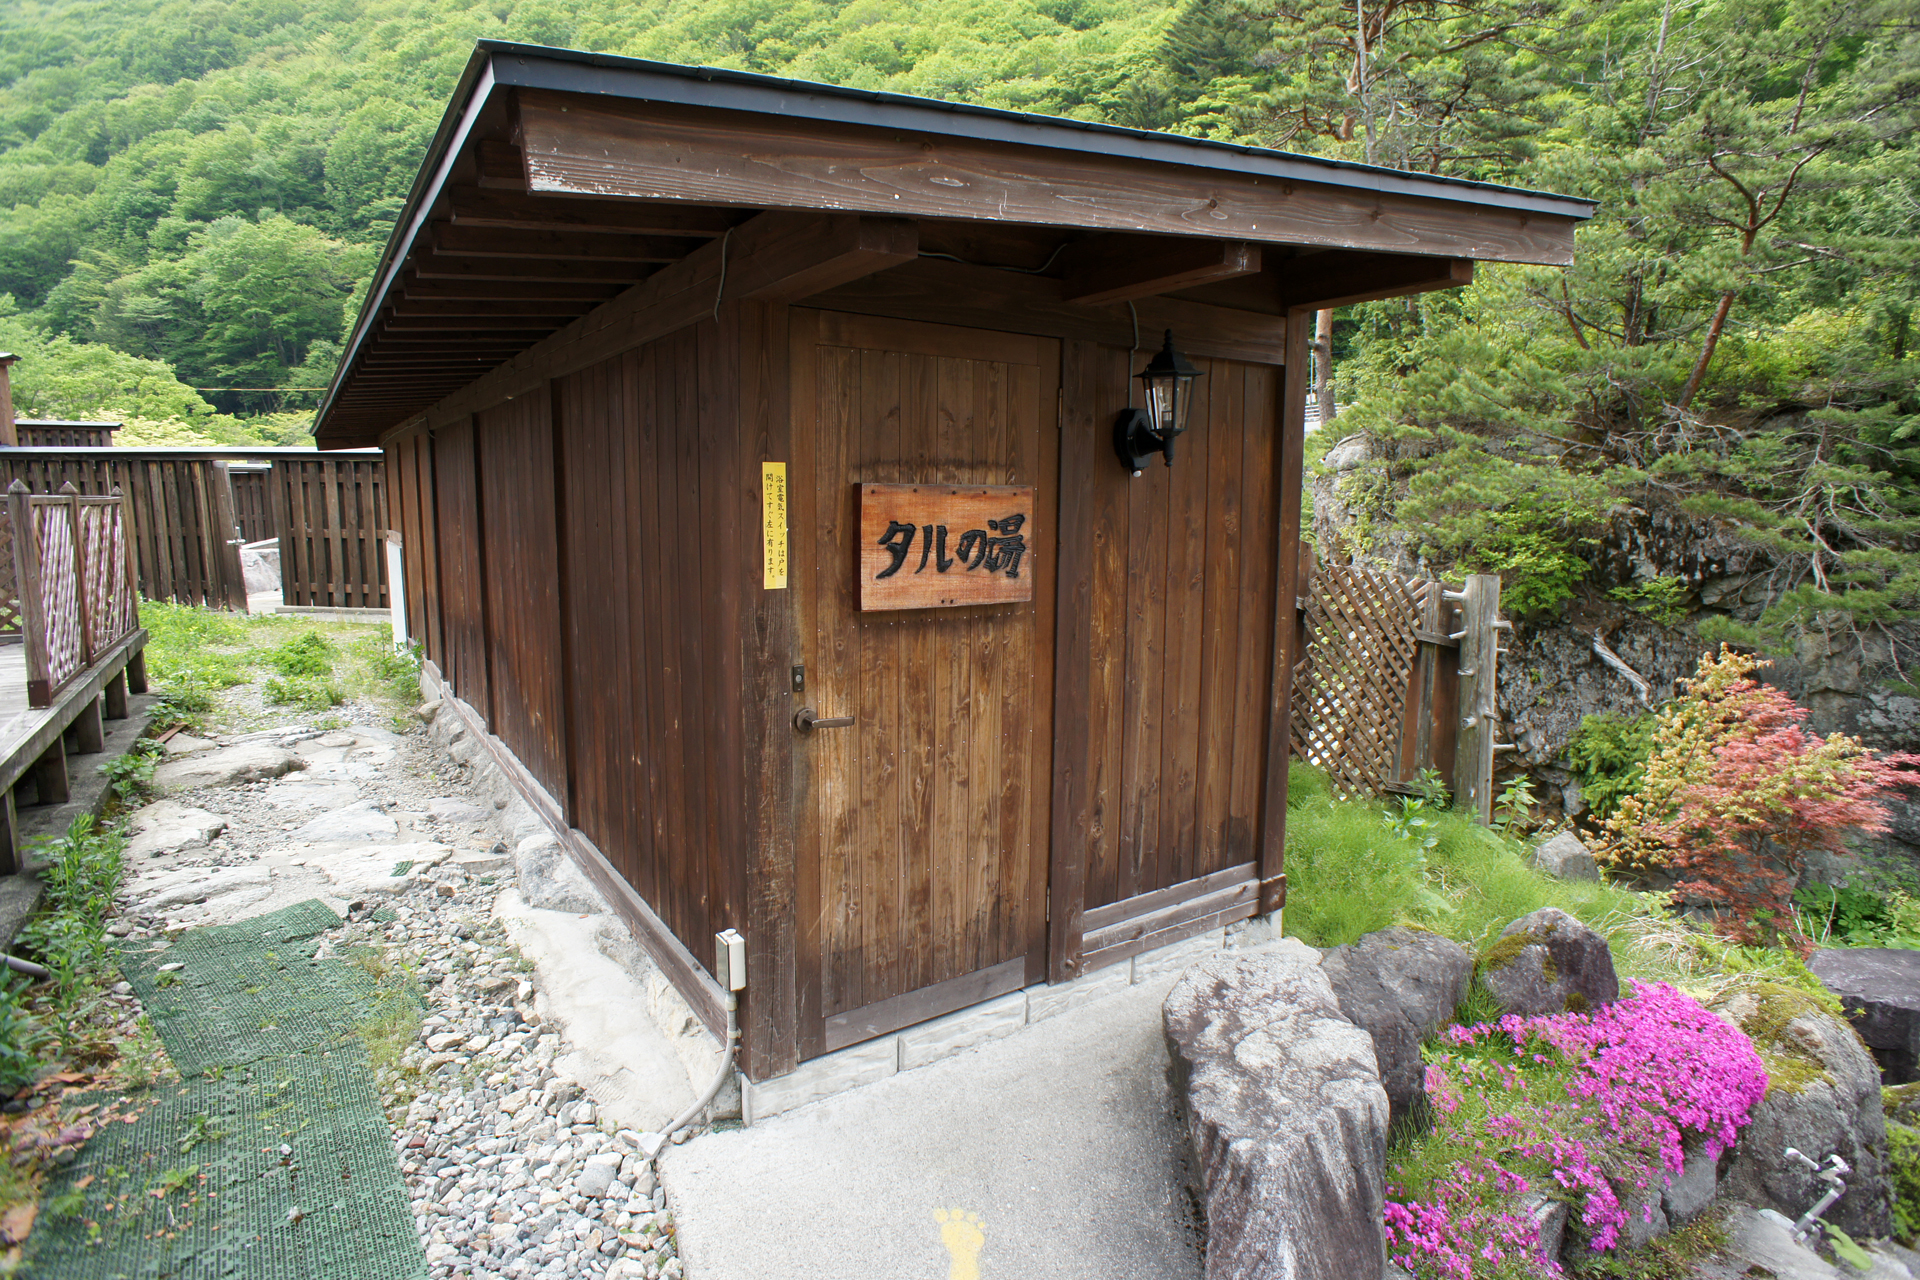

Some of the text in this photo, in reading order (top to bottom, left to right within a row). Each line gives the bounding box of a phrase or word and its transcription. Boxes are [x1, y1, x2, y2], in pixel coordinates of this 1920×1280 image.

[775, 475, 785, 576] 浴室電気スイッチは戸を
[876, 513, 1026, 578] タルの湯
